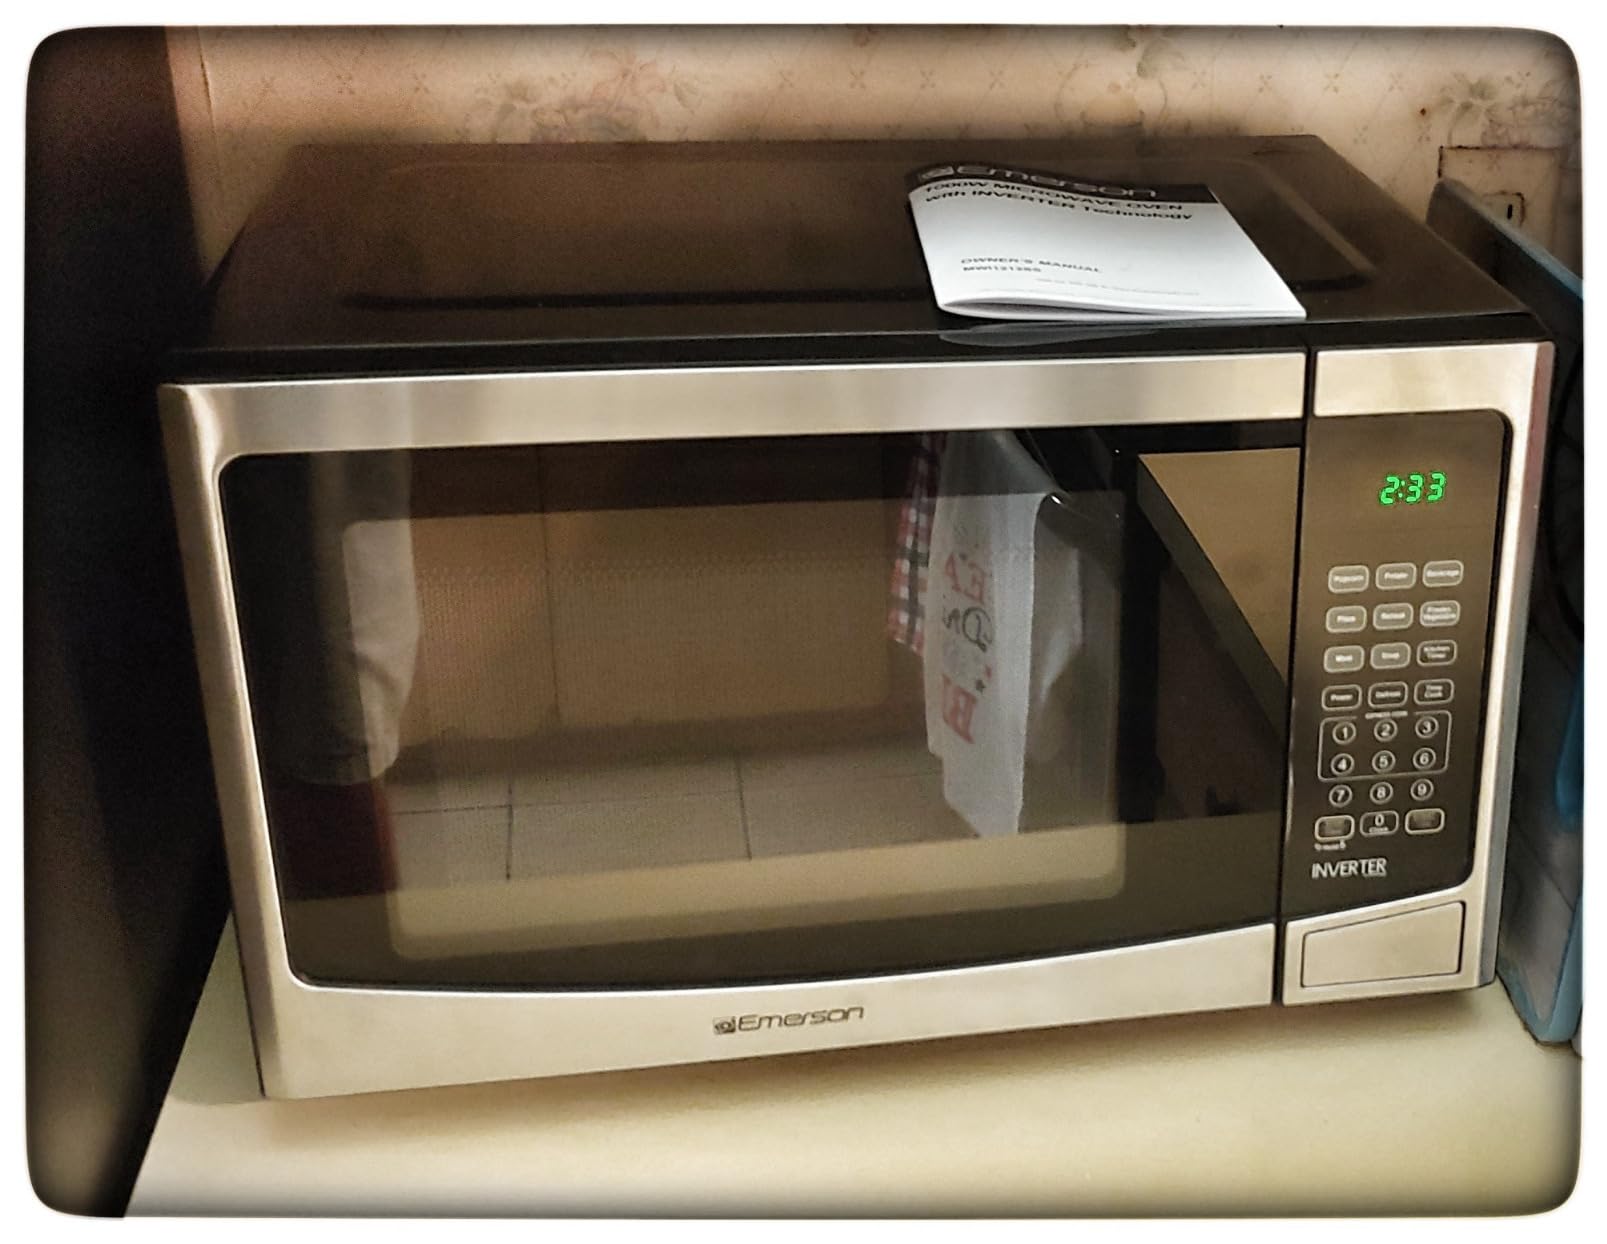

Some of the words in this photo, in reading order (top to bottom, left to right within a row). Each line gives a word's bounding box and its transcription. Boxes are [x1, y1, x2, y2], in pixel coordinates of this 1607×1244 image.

[993, 182, 1117, 206] MICROWAVE
[1126, 202, 1182, 210] OVEN
[925, 190, 966, 202] with
[972, 190, 1075, 209] INVERTER
[1083, 204, 1192, 220] Technology
[1038, 259, 1102, 273] MANUAL
[1380, 472, 1445, 504] 2:33
[1340, 726, 1349, 741] 1
[1380, 723, 1392, 738] 2
[1421, 720, 1432, 734] 3
[1336, 758, 1348, 772] 4
[1378, 754, 1390, 768] 5
[1418, 751, 1430, 765] 6
[1335, 788, 1346, 802] 7
[1375, 786, 1387, 799] 8
[1416, 782, 1427, 797] 9
[1373, 813, 1385, 827] 0
[1311, 857, 1387, 879] INVERTER
[738, 1006, 865, 1033] Emerson
